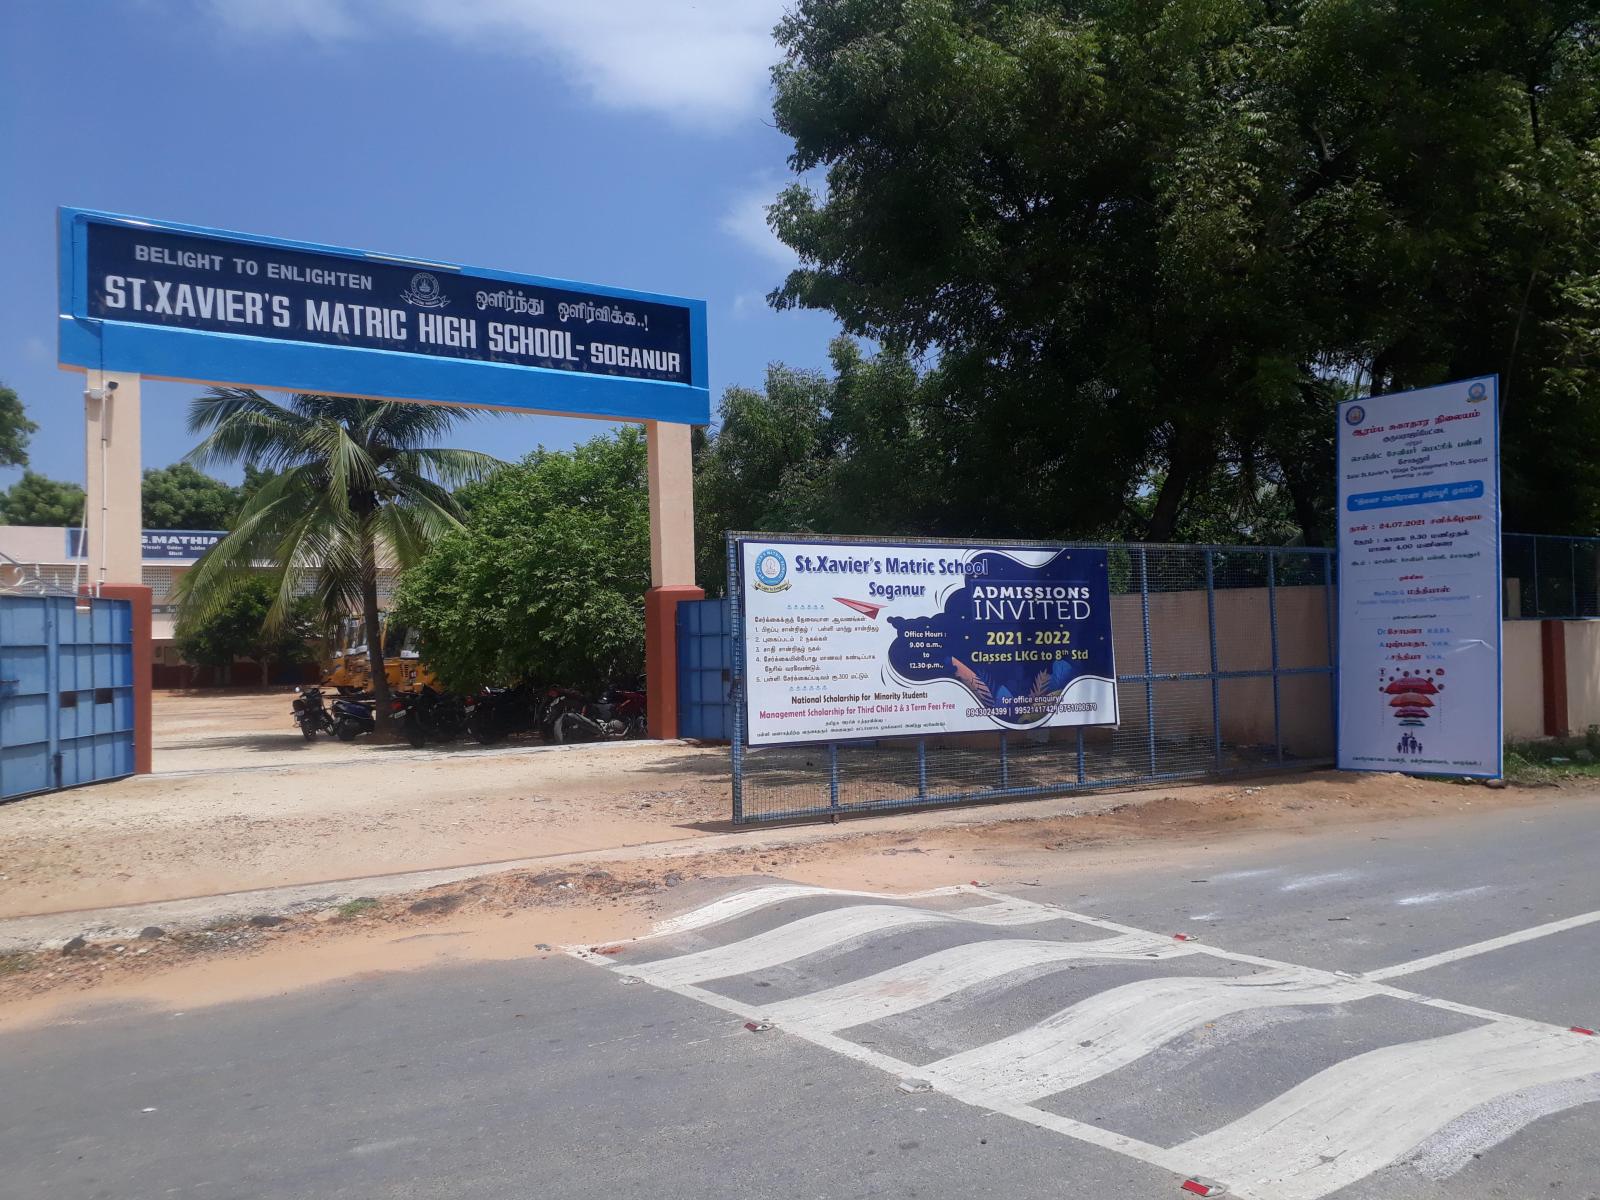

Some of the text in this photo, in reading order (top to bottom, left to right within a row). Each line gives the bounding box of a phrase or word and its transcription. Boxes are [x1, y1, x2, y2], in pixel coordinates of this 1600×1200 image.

[135, 245, 224, 271] BELIGHT
[233, 258, 259, 276] TO
[267, 263, 373, 290] ENLIGHTEN
[475, 289, 545, 316] ஒளிர்ந்து
[104, 275, 291, 328] ST.XAVIER'S
[306, 299, 407, 340] MATRIC
[418, 312, 477, 349] HIGH
[590, 342, 681, 373] SOGANUR
[795, 555, 882, 574] St.Xavier's
[885, 558, 935, 575] Matric
[938, 559, 989, 576] School
[868, 582, 926, 600] Soganur
[972, 586, 1090, 599] ADMISSIONS
[974, 600, 1091, 621] INVITED
[904, 630, 923, 638] Office
[924, 630, 943, 638] Hours
[986, 631, 1022, 646] 2021
[1034, 631, 1071, 645] 2022
[971, 649, 1088, 663] Classes LKG to 8th Std
[791, 692, 928, 705] National Scholarship for Minority Students
[1001, 696, 1012, 704] for
[1013, 696, 1033, 704] office
[759, 710, 806, 720] Management
[807, 708, 845, 718] Scholarship
[846, 707, 856, 715] for
[857, 706, 875, 714] Third
[876, 705, 893, 713] Child
[899, 704, 905, 712] &
[910, 704, 926, 712] Term
[927, 703, 942, 711] Fees
